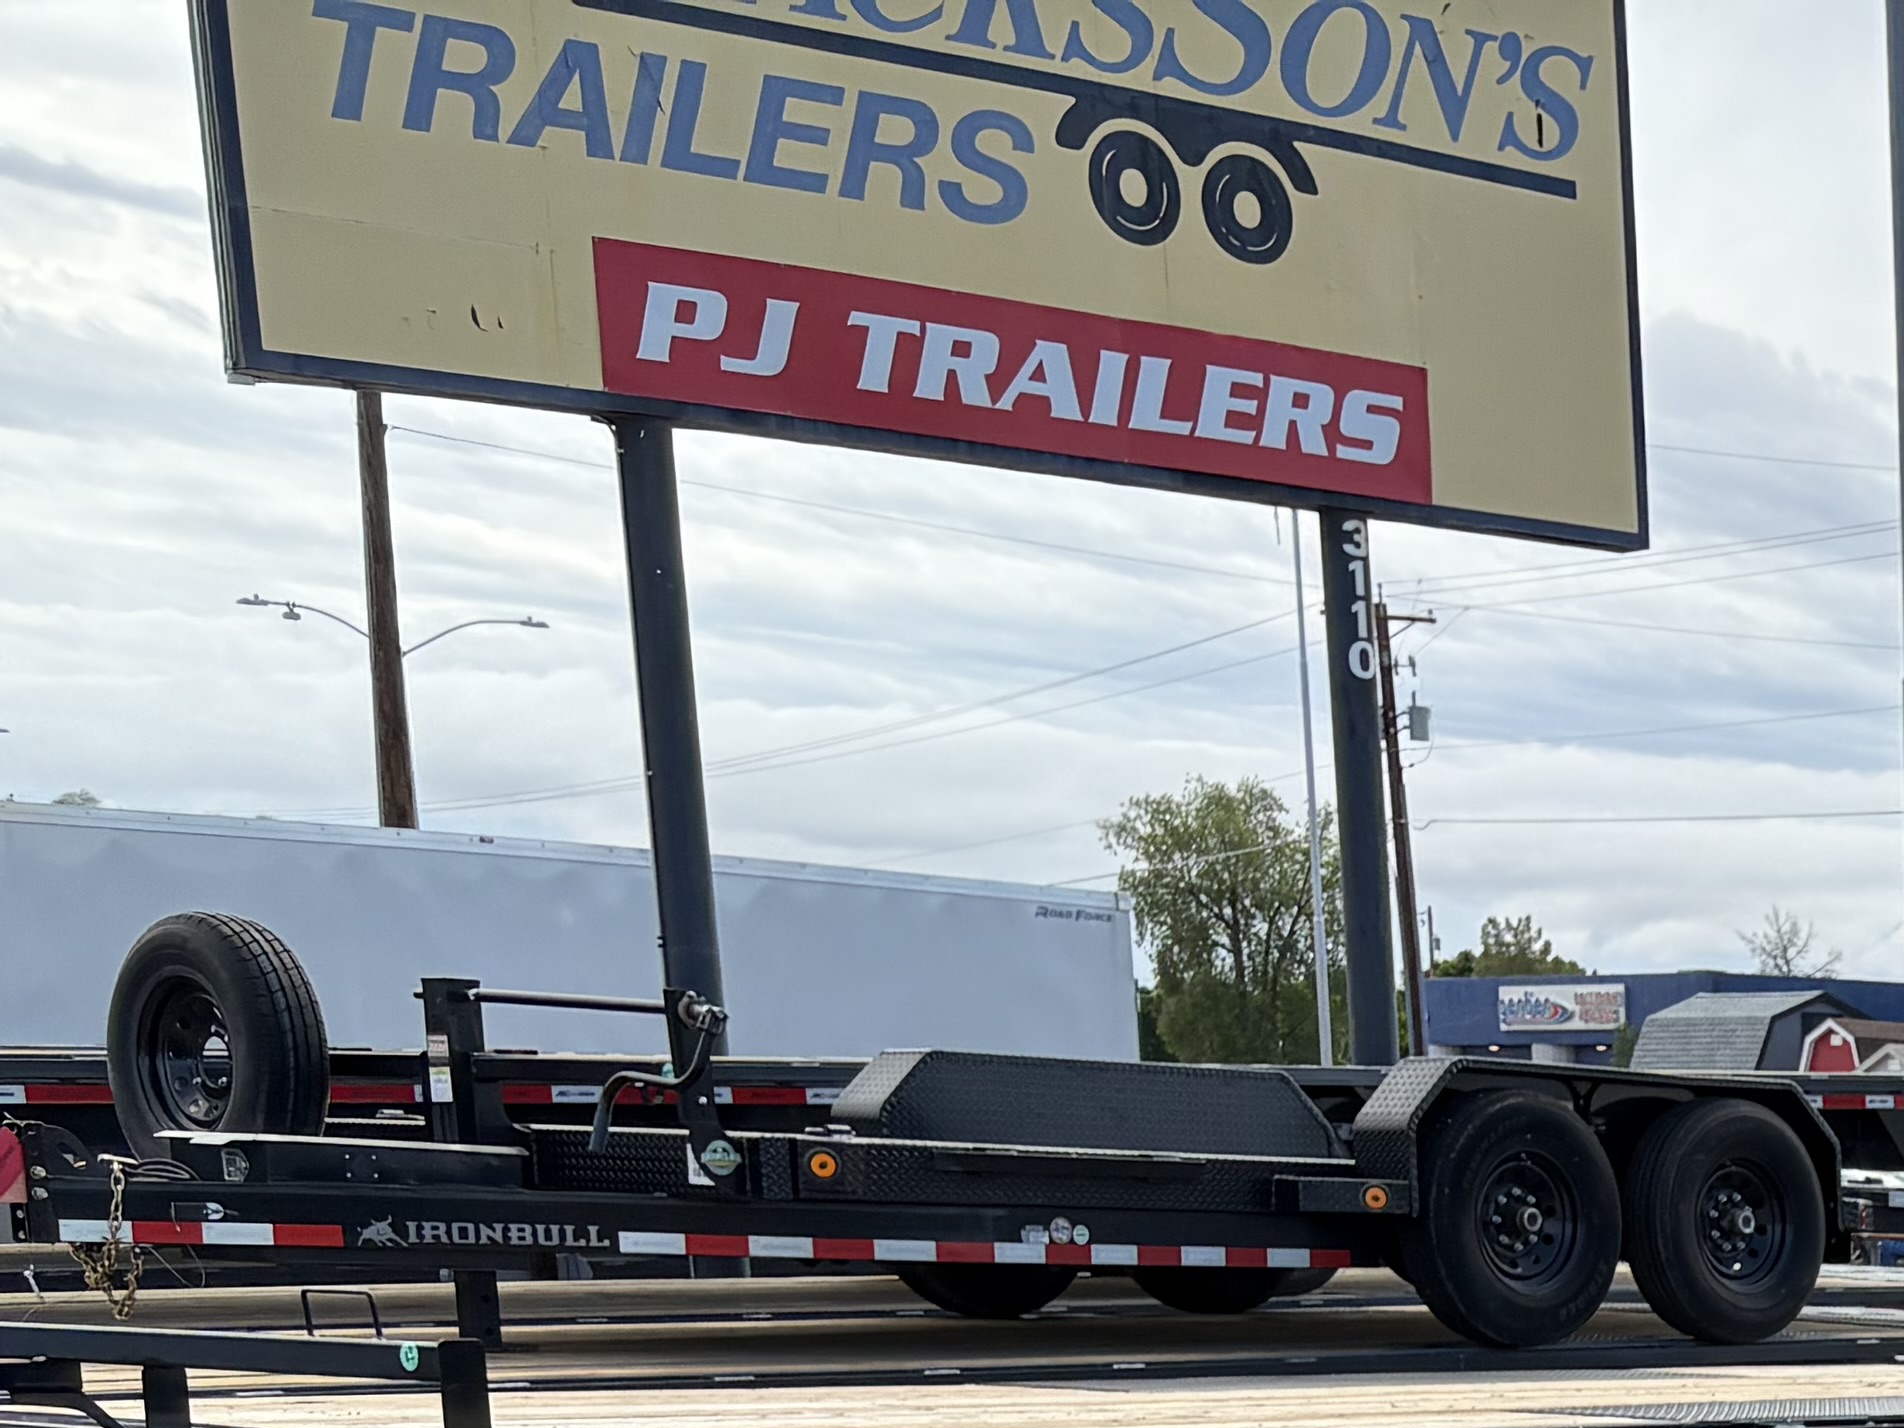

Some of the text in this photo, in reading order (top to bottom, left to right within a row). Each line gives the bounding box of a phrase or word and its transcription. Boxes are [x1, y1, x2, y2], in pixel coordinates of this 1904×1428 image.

[312, 0, 1035, 226] TRAILERS
[635, 280, 1406, 466] PJ TRAILERS
[405, 1221, 611, 1248] IRONBULL
